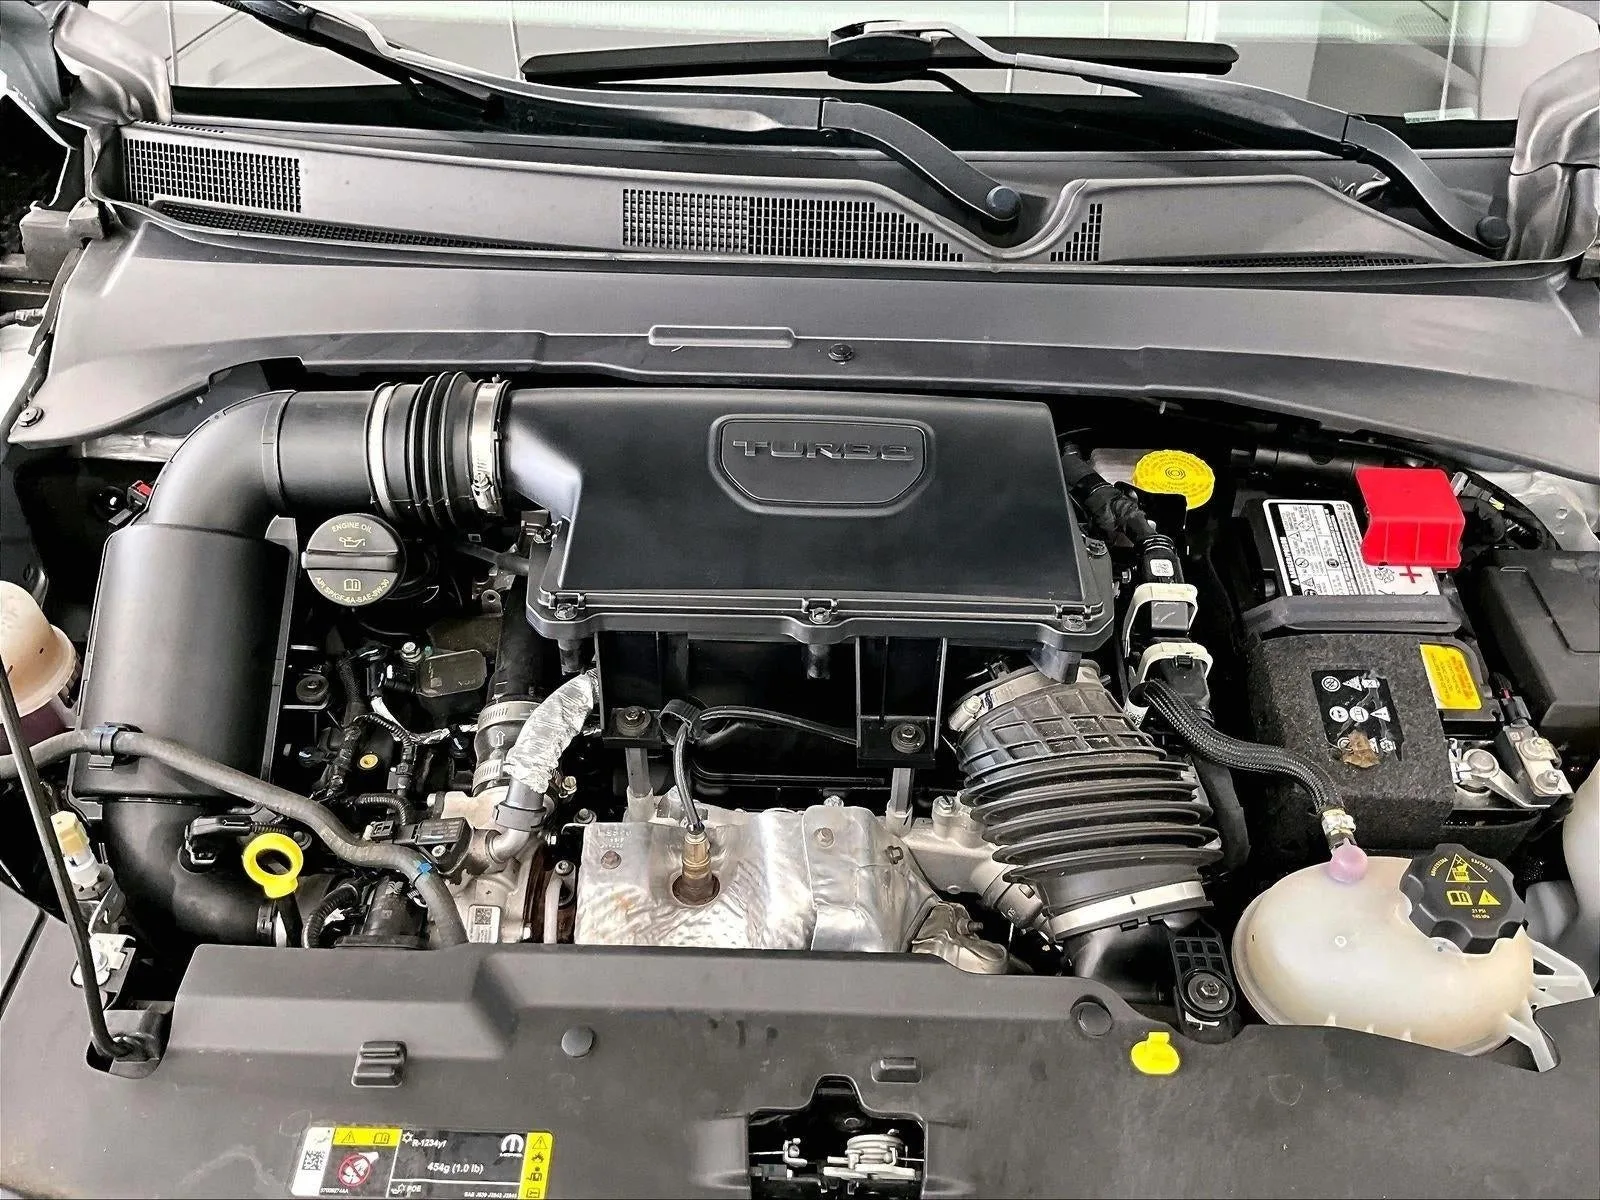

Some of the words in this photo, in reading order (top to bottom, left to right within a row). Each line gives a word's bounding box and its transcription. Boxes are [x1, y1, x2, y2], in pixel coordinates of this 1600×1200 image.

[732, 440, 915, 461] TURBO
[331, 522, 360, 533] ENGINE
[361, 522, 373, 534] OIL
[427, 1161, 450, 1174] 454g
[452, 1163, 470, 1175] (1.0
[470, 1163, 484, 1175] lb)
